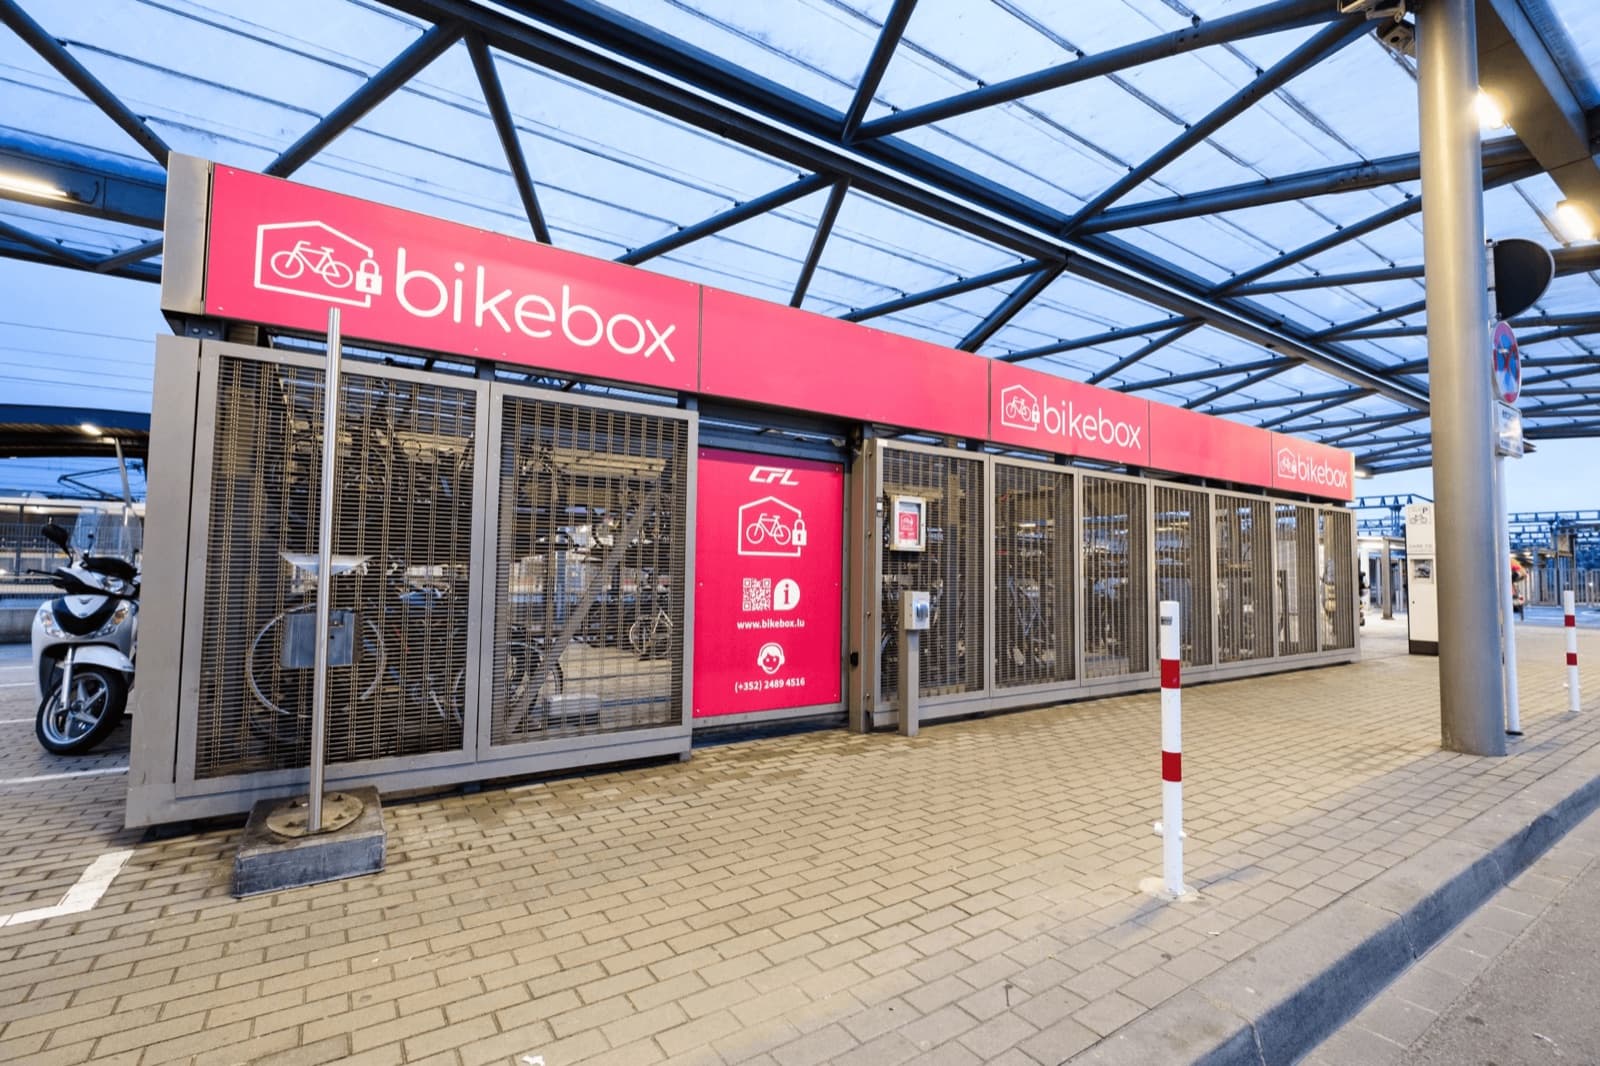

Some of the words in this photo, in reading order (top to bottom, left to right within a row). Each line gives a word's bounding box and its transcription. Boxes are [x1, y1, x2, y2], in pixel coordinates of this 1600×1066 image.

[395, 247, 676, 363] bikebox
[1043, 396, 1142, 450] bikebox
[748, 465, 800, 486] CFL
[1297, 452, 1348, 489] bikebox
[736, 618, 805, 630] www.bikebox.lu
[734, 681, 762, 693] (+352)
[764, 679, 784, 690] 2489
[785, 677, 806, 687] 4516
